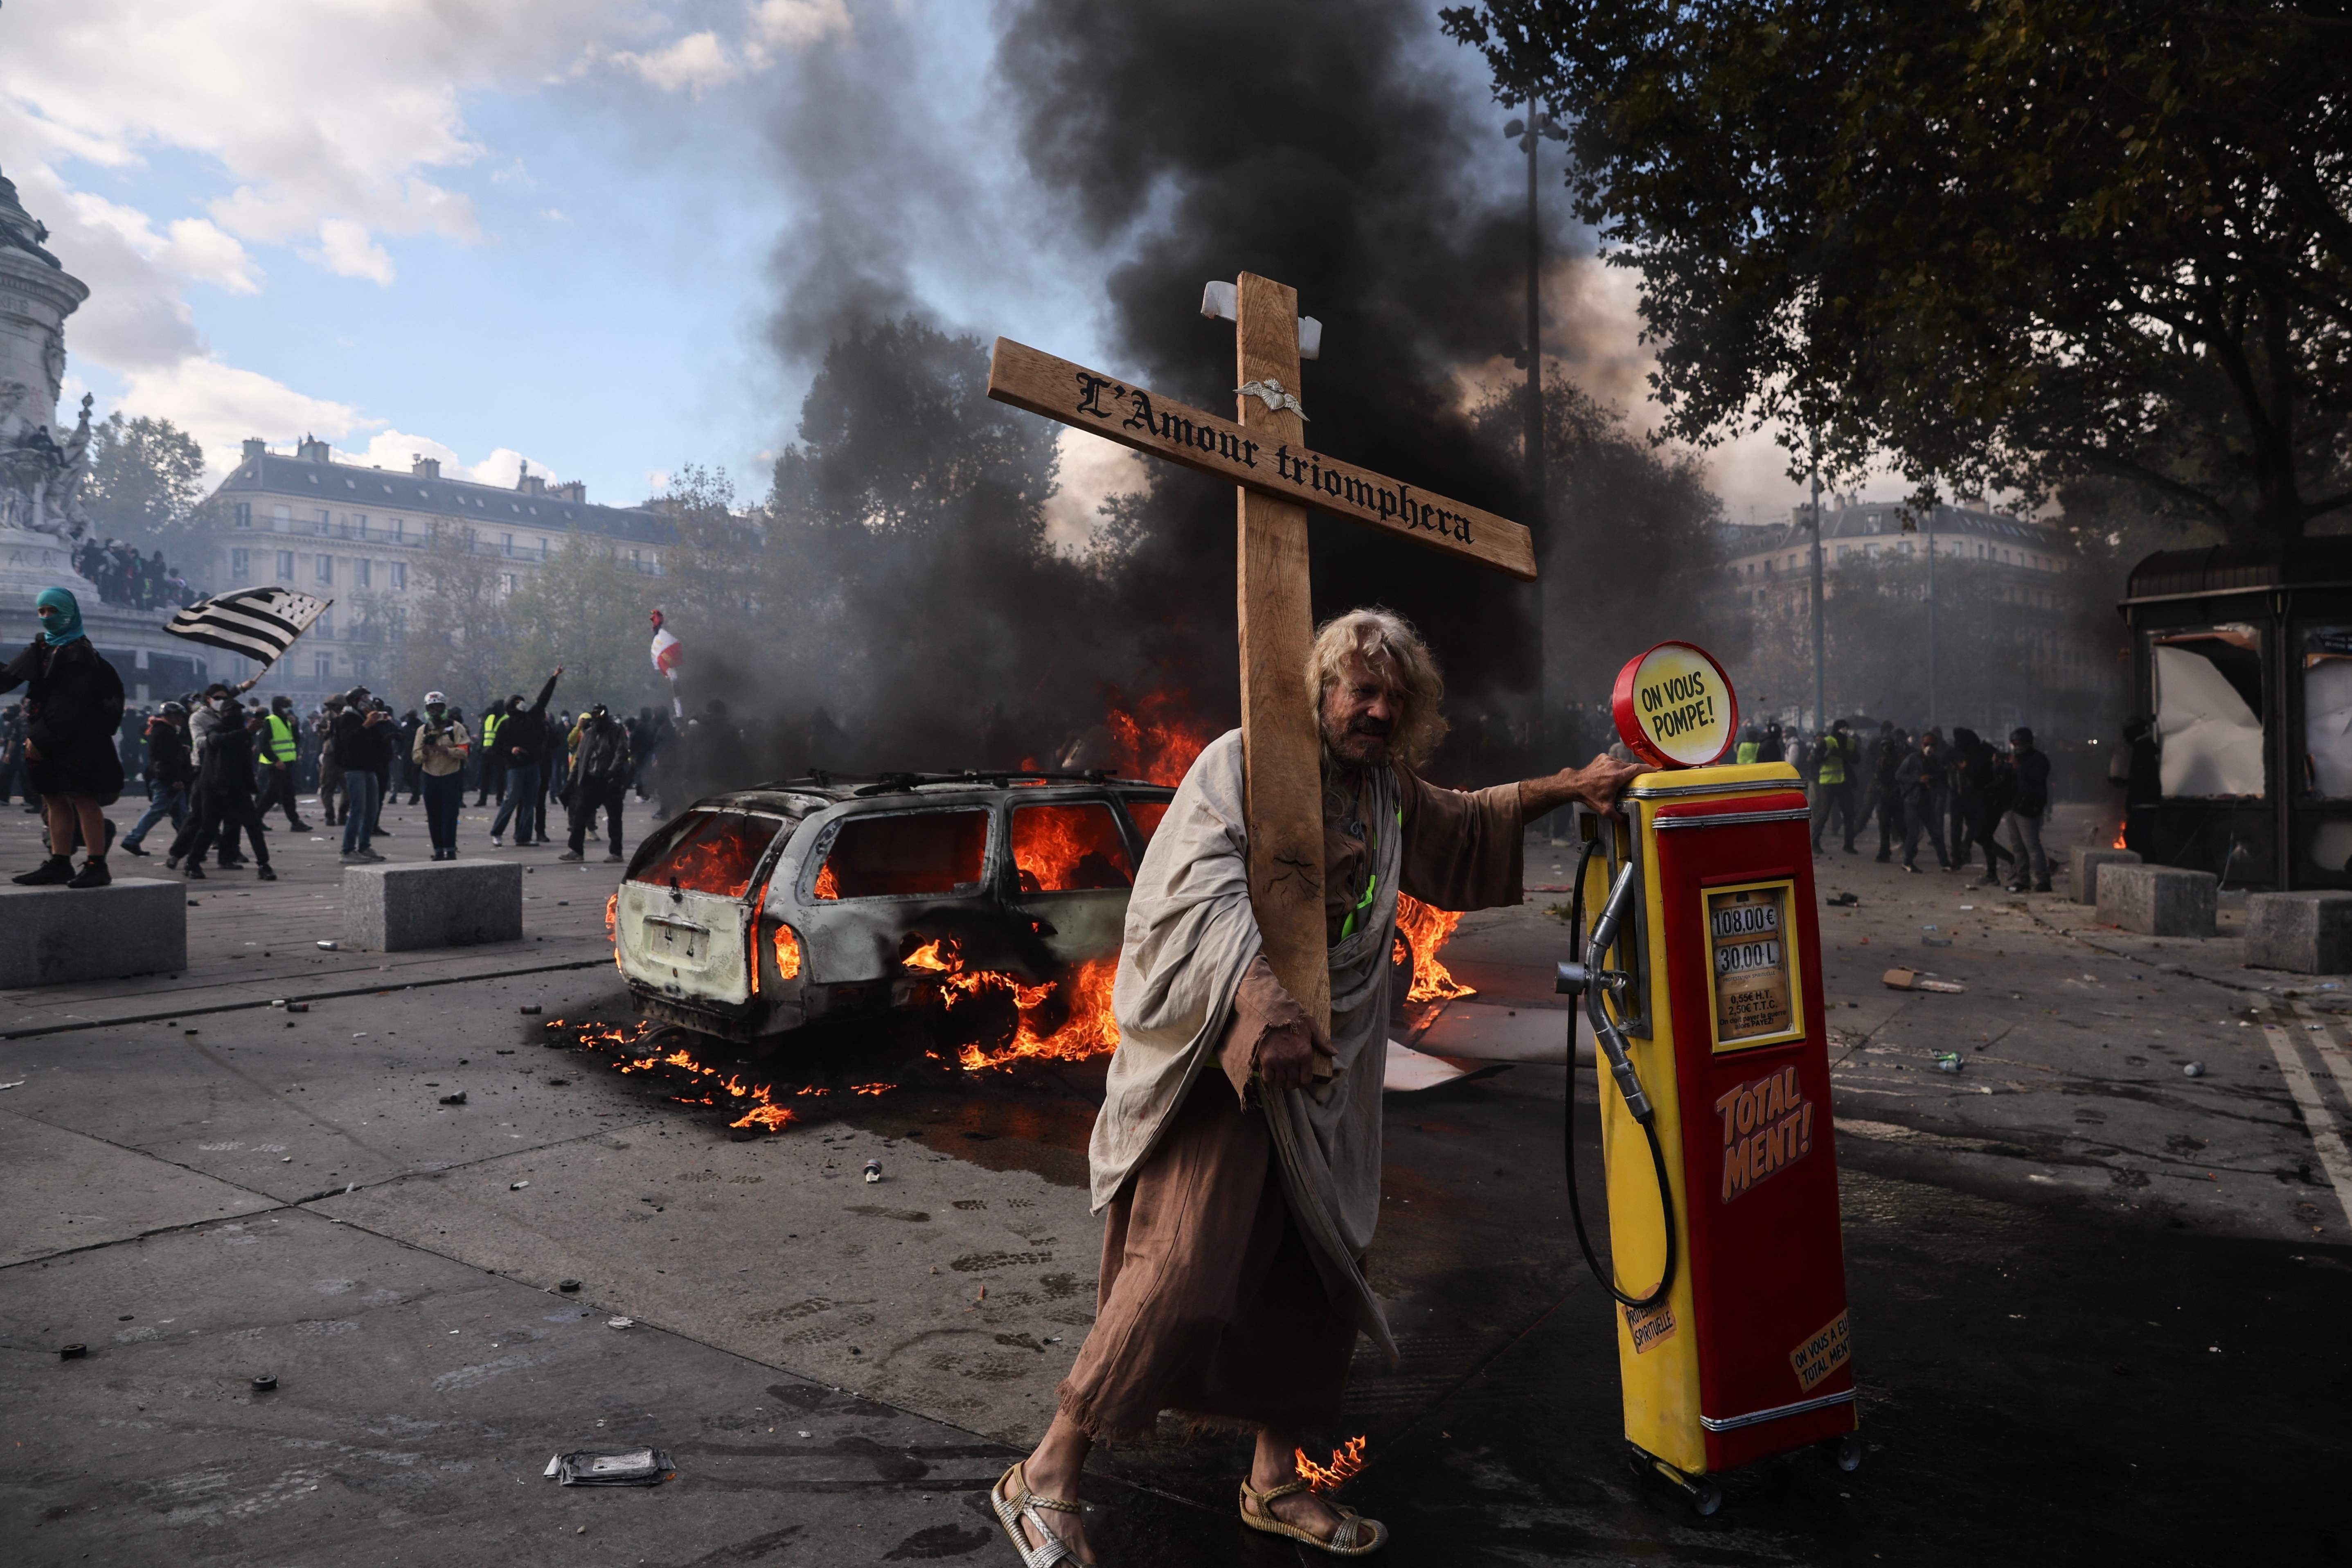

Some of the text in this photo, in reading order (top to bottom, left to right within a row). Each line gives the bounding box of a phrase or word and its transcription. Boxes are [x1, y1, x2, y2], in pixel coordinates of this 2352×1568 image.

[1076, 372, 1475, 545] L'Amour triomphera
[1642, 671, 1705, 712] ON VOUS
[1652, 696, 1714, 742] POMPE!
[1714, 908, 1775, 935] 108,00 €
[1721, 943, 1775, 971] 30,00 L
[1729, 1000, 1778, 1016] 2,50€ T.T.C.
[1756, 990, 1772, 1000] H.T.
[1743, 1014, 1759, 1023] payer
[1767, 1010, 1787, 1019] guerre
[1717, 1067, 1800, 1145] TOTAL
[1723, 1102, 1812, 1201] MENT!
[1635, 1310, 1673, 1347] SPIRITUELLE
[1795, 1349, 1807, 1368] ON
[1808, 1333, 1829, 1358] VOUS
[1831, 1328, 1837, 1343] A
[1802, 1357, 1829, 1385] TOTAL
